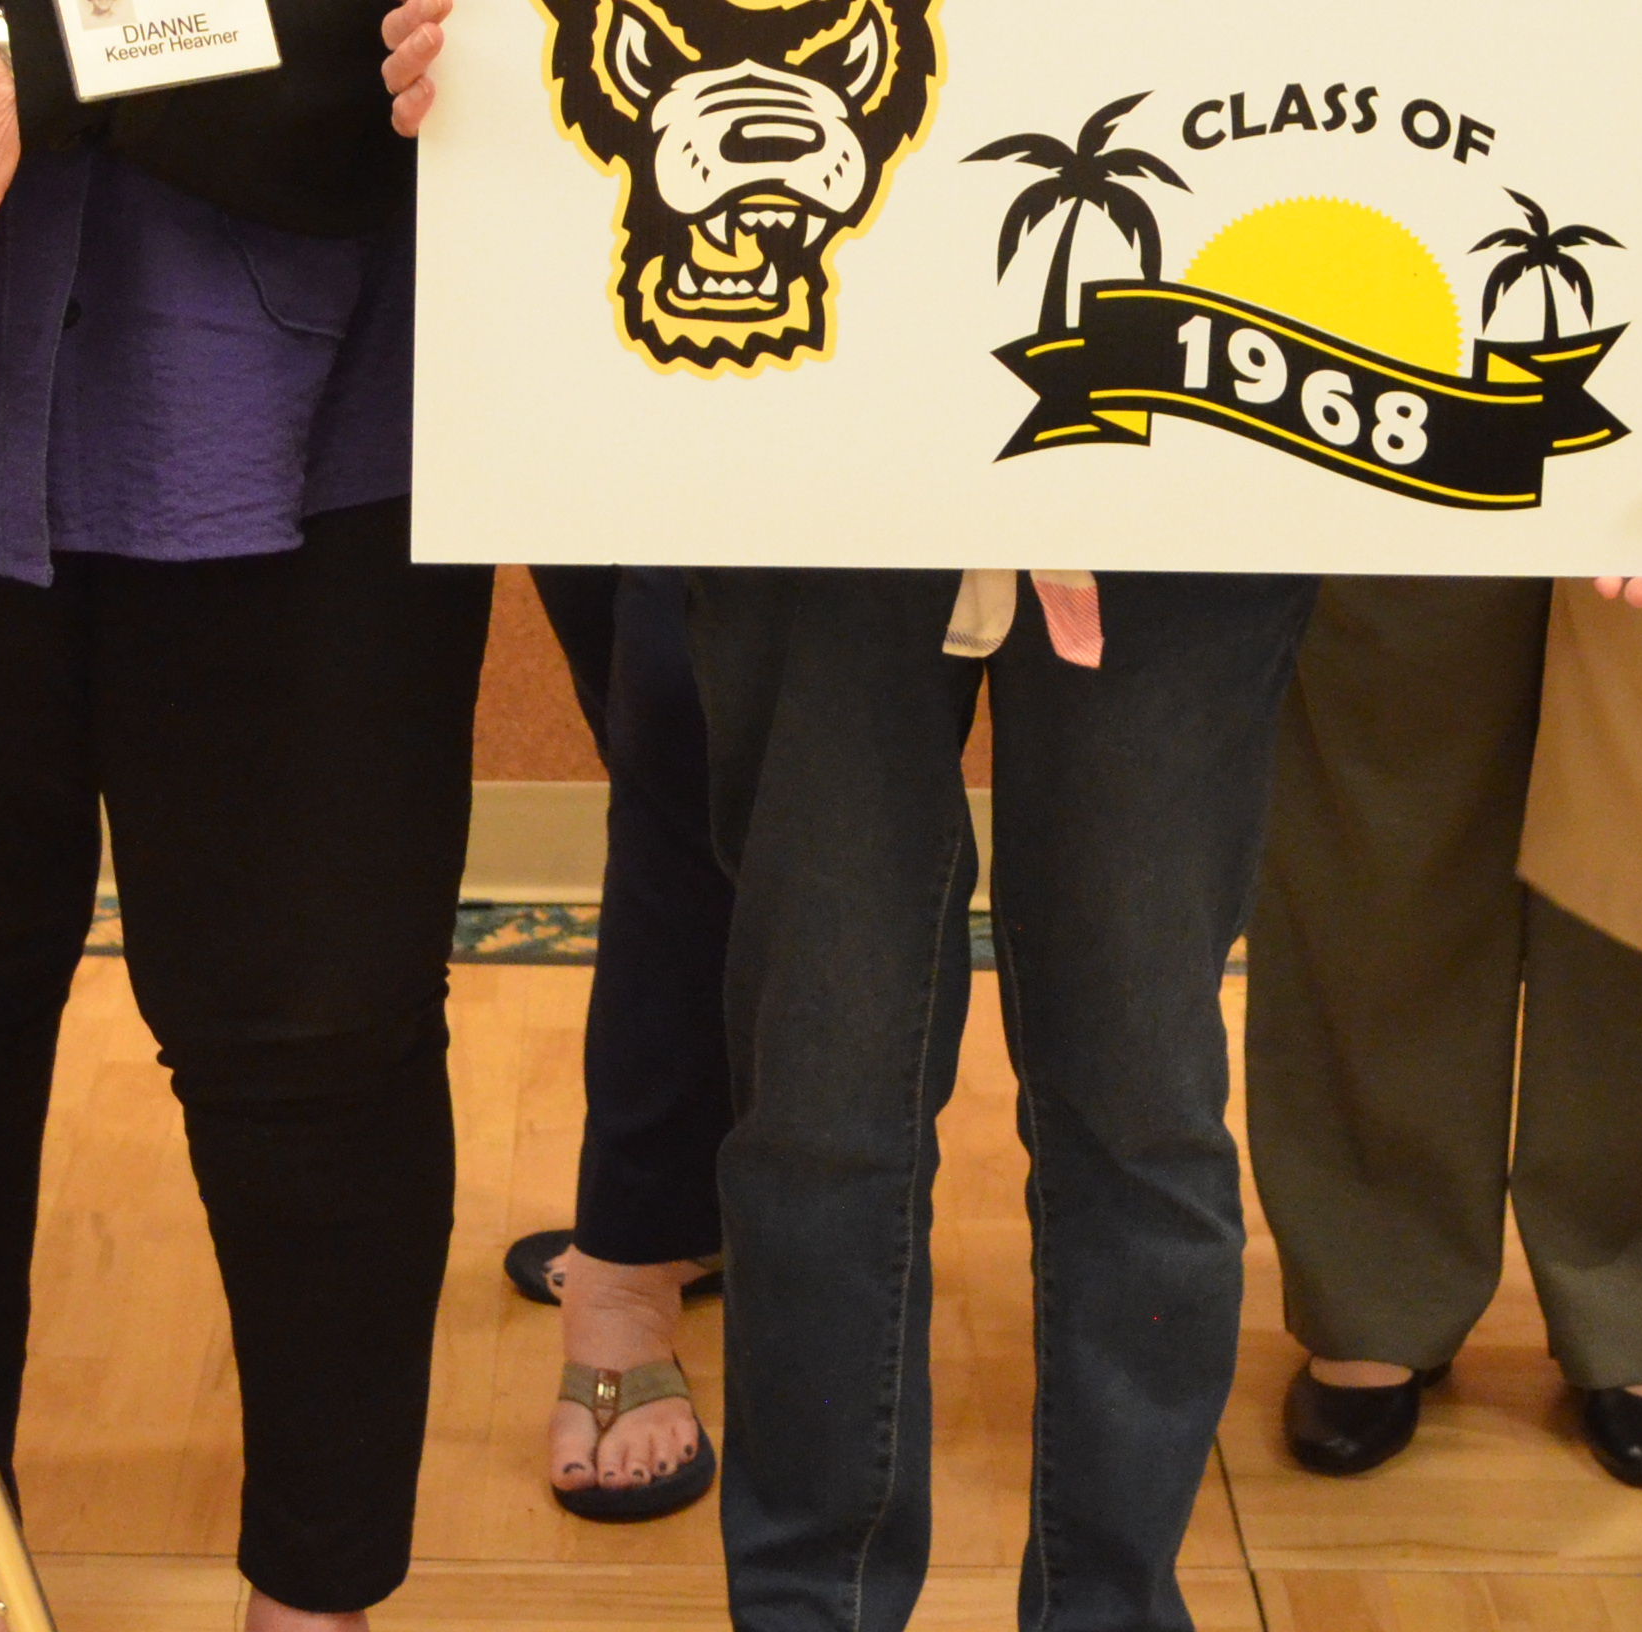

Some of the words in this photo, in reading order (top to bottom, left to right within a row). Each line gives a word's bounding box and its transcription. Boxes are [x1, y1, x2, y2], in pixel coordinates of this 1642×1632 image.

[105, 41, 165, 62] Keever
[170, 28, 239, 53] Heavner
[122, 13, 210, 44] DIANNE
[1182, 83, 1378, 150] CLASS
[1401, 99, 1495, 164] OF
[1177, 315, 1428, 465] 1968
